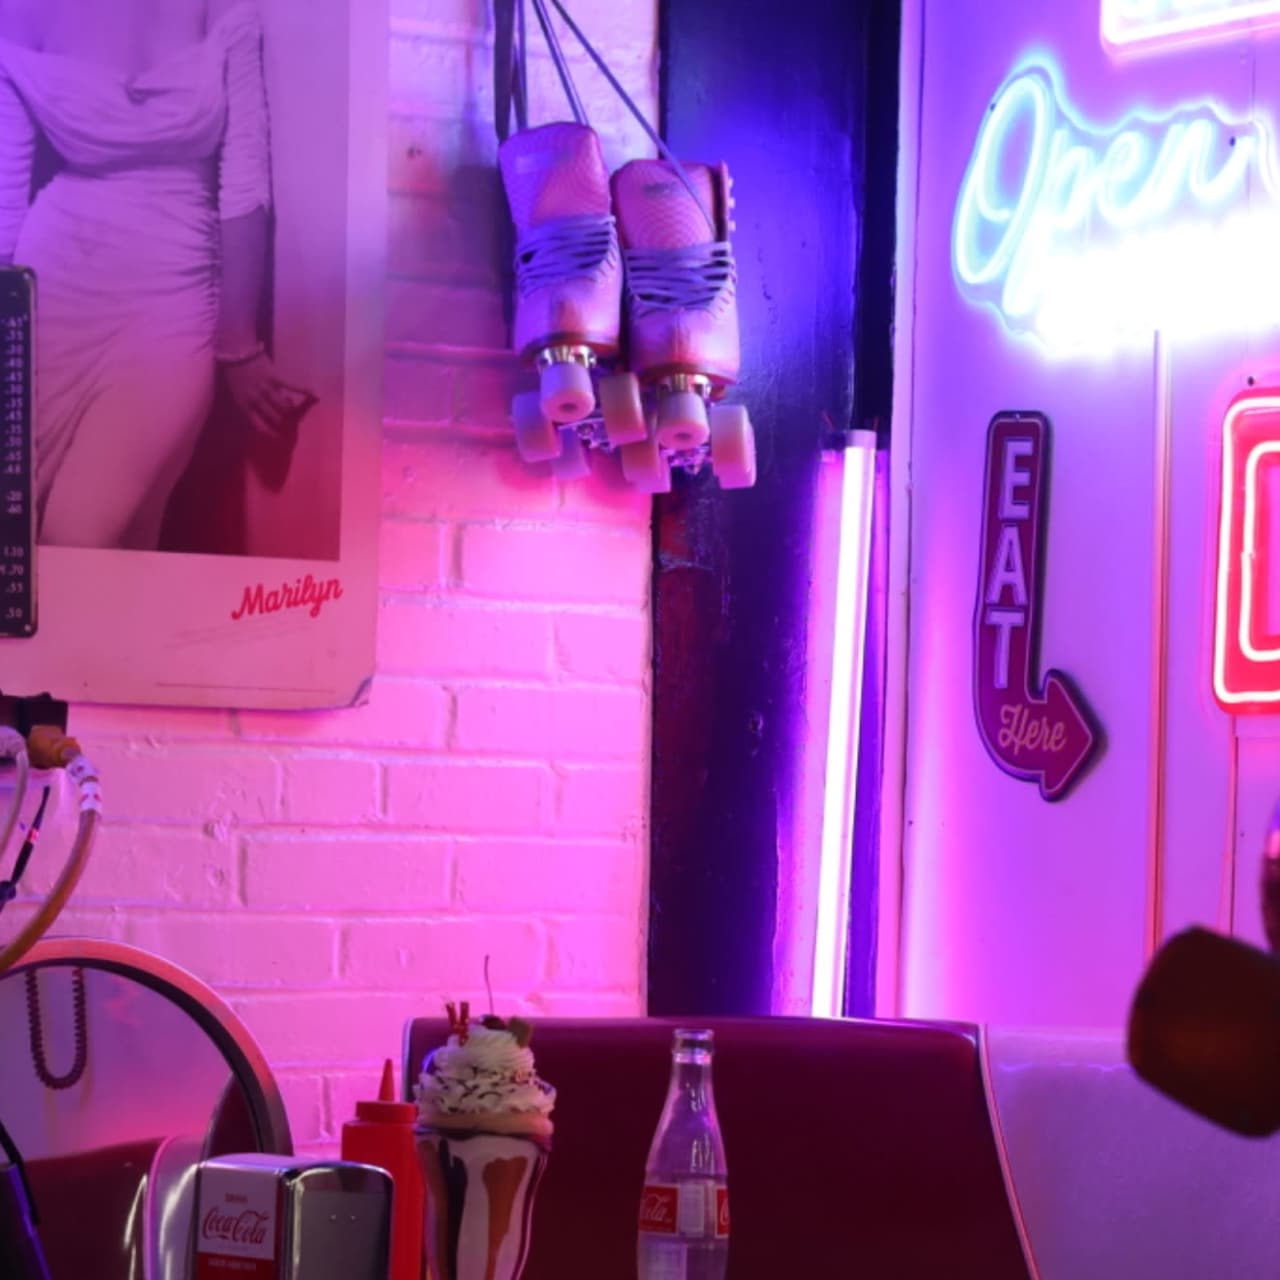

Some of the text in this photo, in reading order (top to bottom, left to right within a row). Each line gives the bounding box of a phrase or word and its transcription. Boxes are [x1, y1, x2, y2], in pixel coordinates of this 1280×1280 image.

[955, 74, 1258, 315] Open
[230, 573, 344, 621] Marilyn
[984, 436, 1034, 690] EAT
[997, 703, 1067, 756] Here
